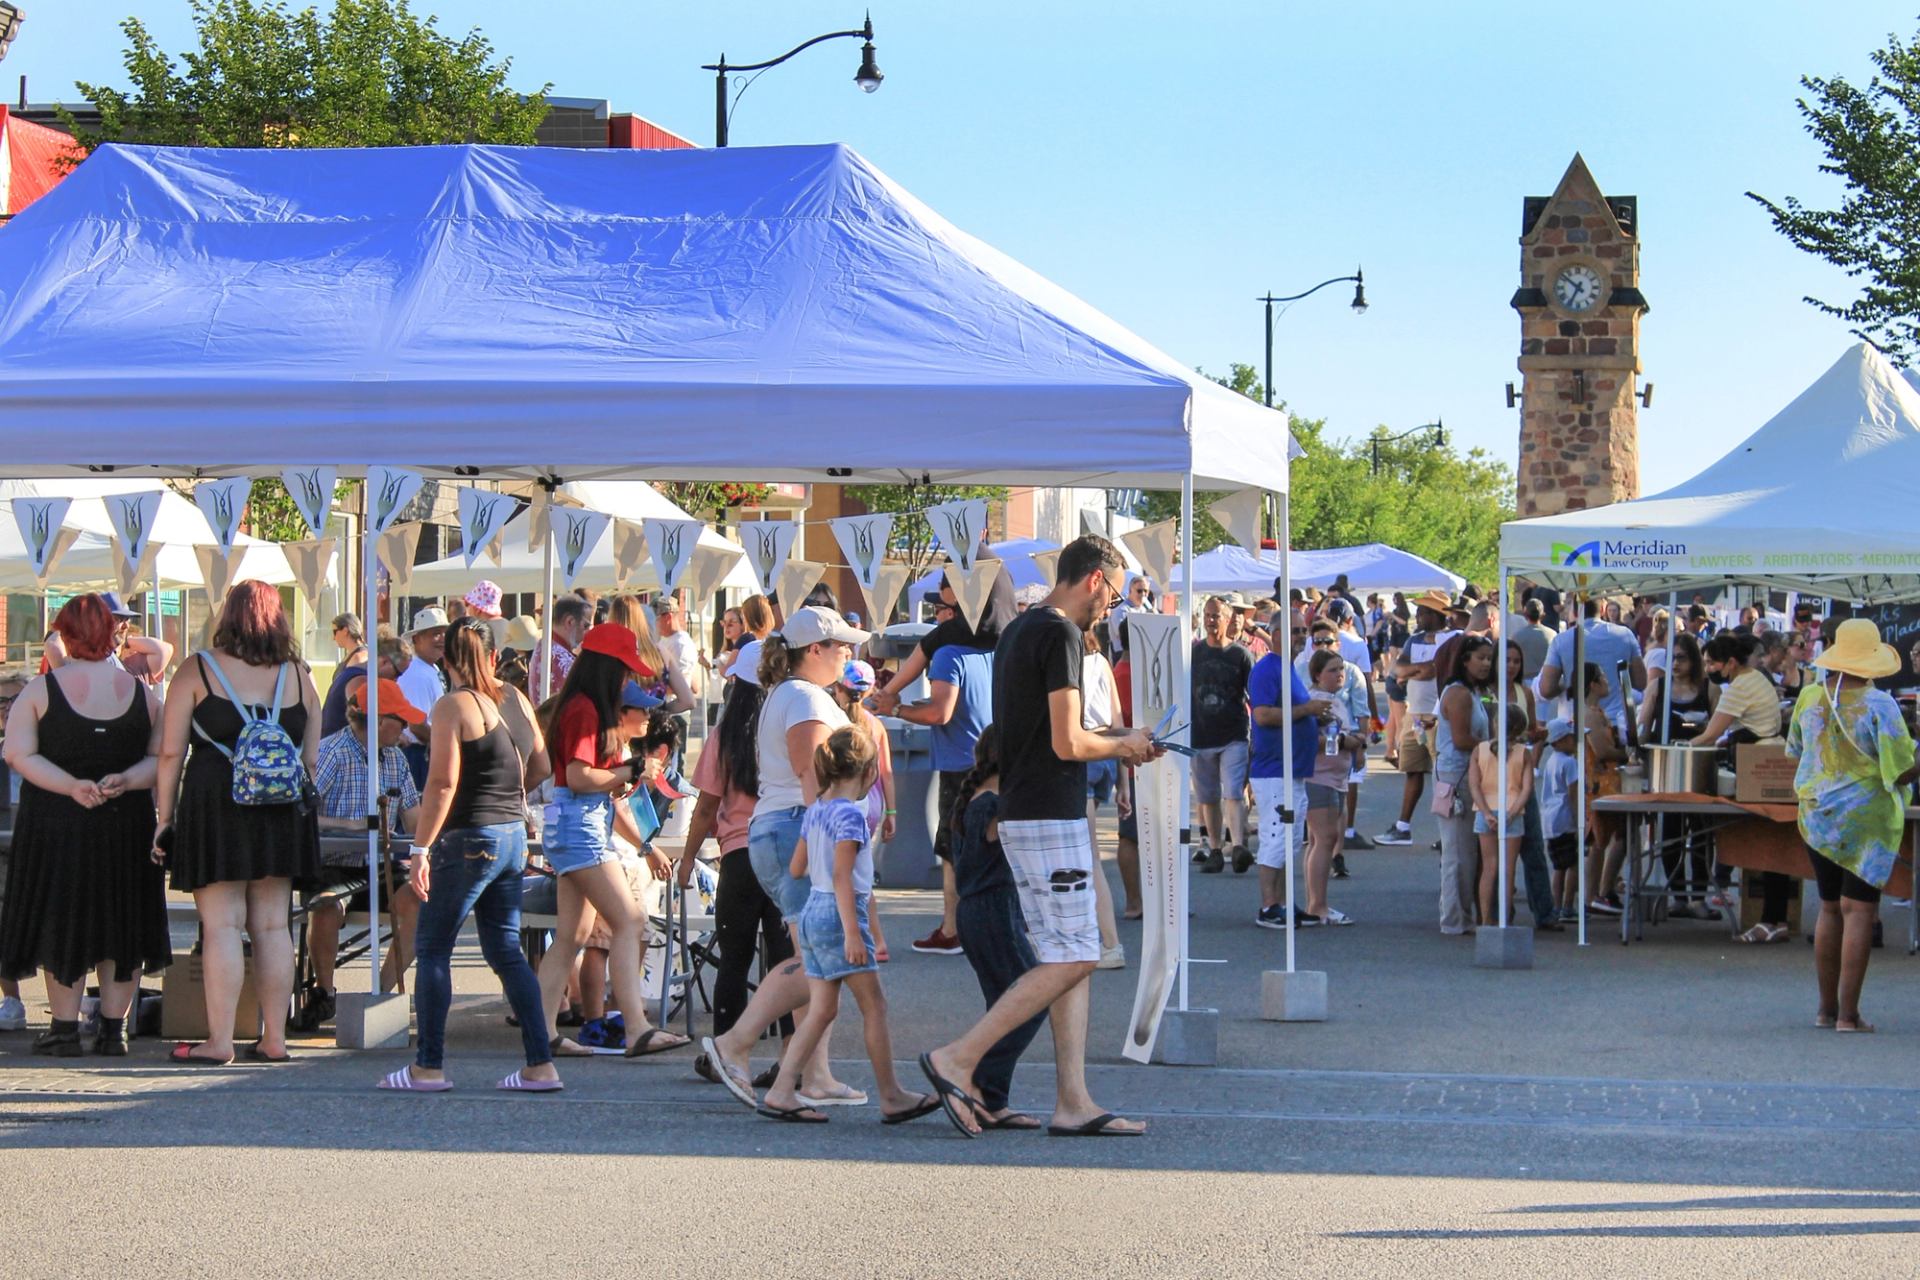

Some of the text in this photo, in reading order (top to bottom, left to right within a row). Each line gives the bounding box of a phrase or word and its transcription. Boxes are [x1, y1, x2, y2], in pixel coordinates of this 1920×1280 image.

[1604, 540, 1686, 555] Meridian
[1604, 558, 1669, 571] Law Group
[1690, 554, 1752, 567] LAWYERS
[1764, 553, 1853, 566] ARBITRATORS
[1143, 805, 1151, 835] JULY
